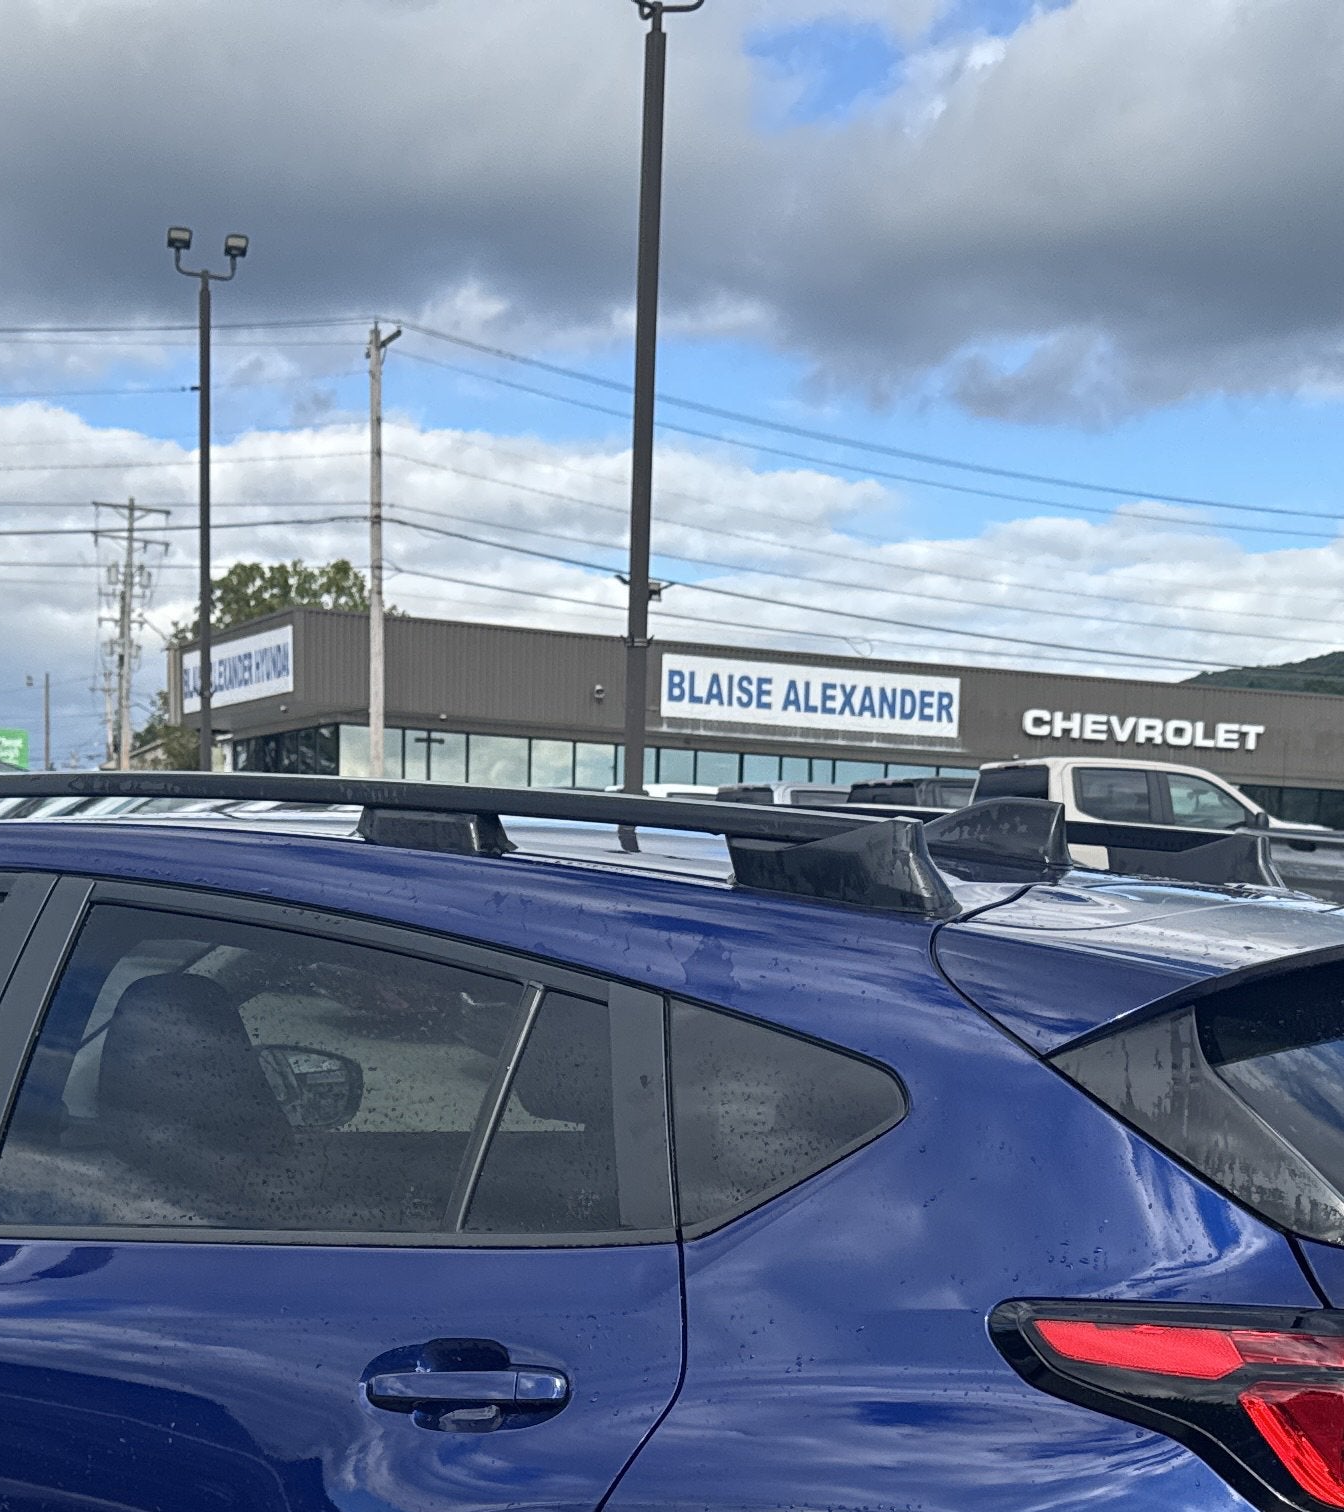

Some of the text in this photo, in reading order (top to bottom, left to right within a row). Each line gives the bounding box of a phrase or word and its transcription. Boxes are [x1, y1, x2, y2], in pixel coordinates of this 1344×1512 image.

[667, 669, 954, 723] BLAISE ALEXANDER
[1022, 708, 1266, 750] CHEVROLET
